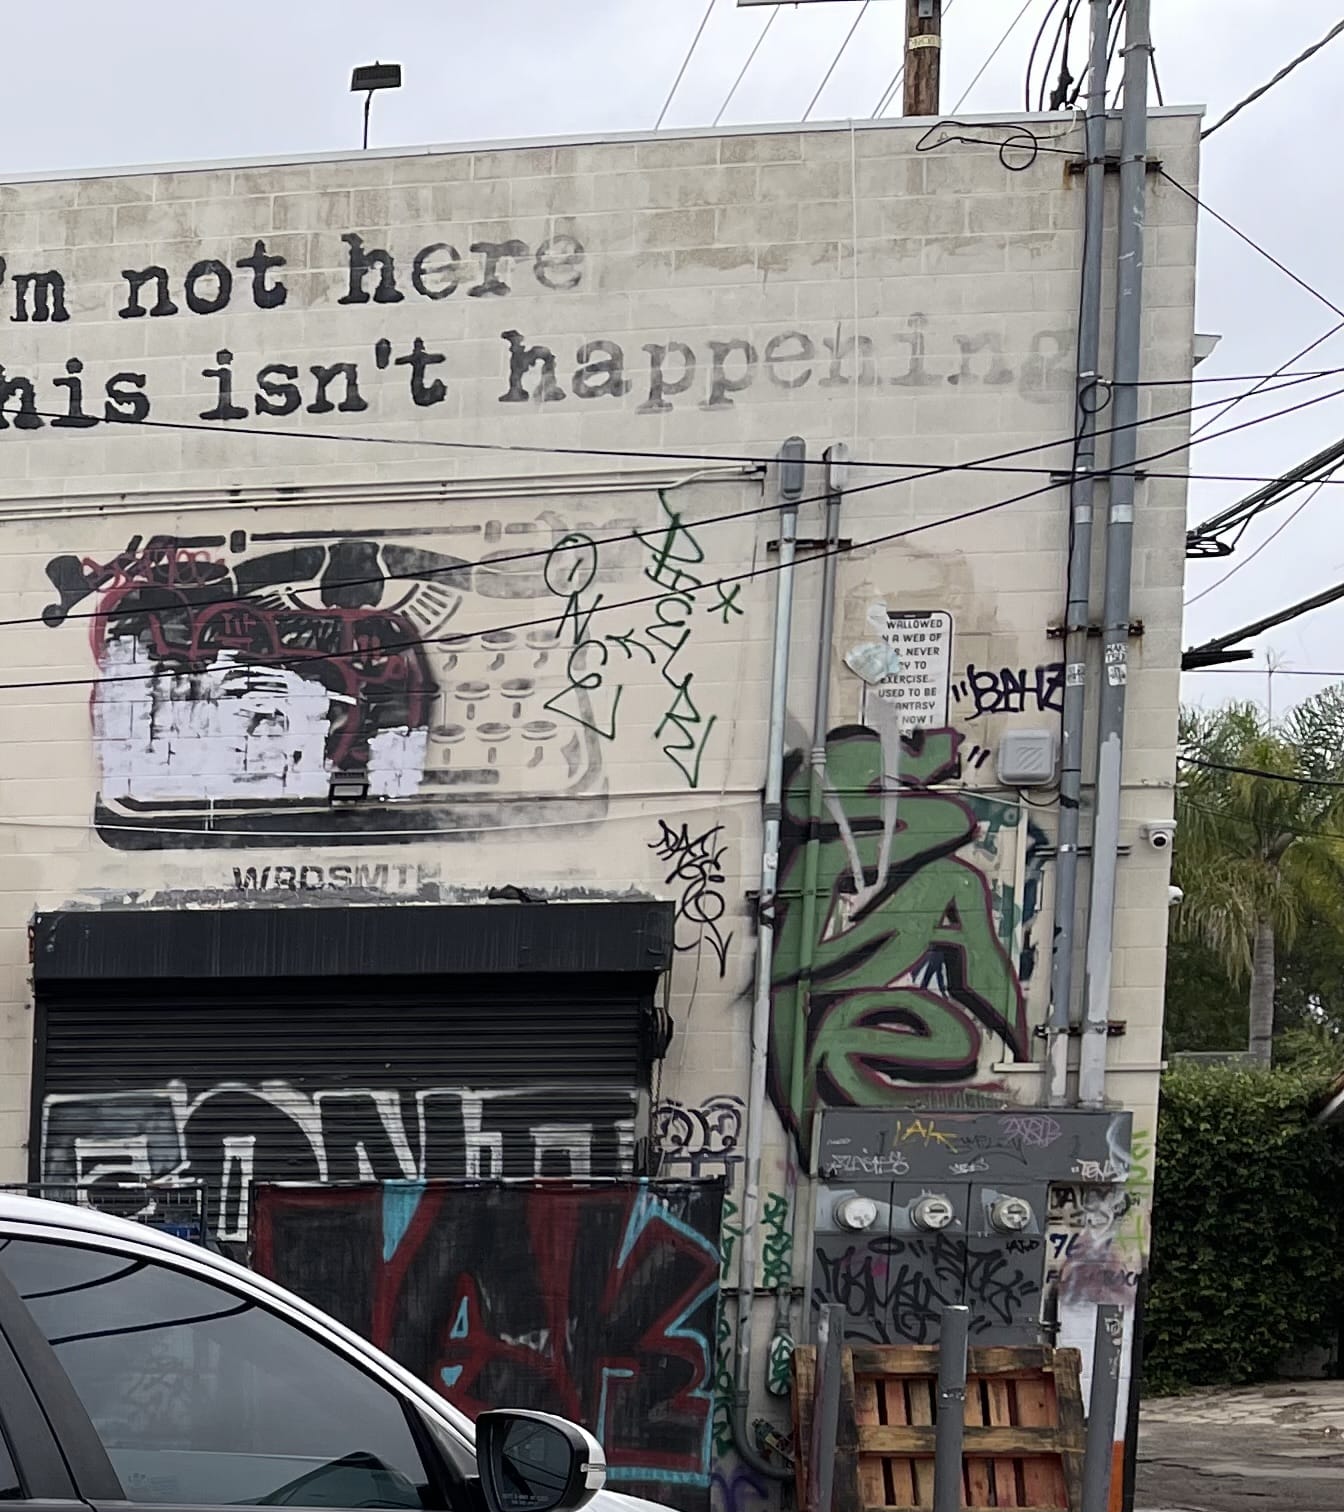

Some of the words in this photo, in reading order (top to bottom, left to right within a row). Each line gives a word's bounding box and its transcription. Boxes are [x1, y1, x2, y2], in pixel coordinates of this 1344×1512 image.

[118, 239, 288, 322] not
[337, 232, 585, 304] here
[197, 336, 449, 422] isn't
[499, 312, 1077, 414] happening
[903, 634, 926, 642] WEB
[929, 633, 942, 642] OF
[906, 647, 940, 656] NEVER
[915, 661, 927, 669] TO
[878, 689, 905, 698] USED
[908, 689, 921, 697] TO
[924, 688, 937, 696] BE
[895, 701, 936, 710] ANTASY
[902, 716, 926, 725] NOW
